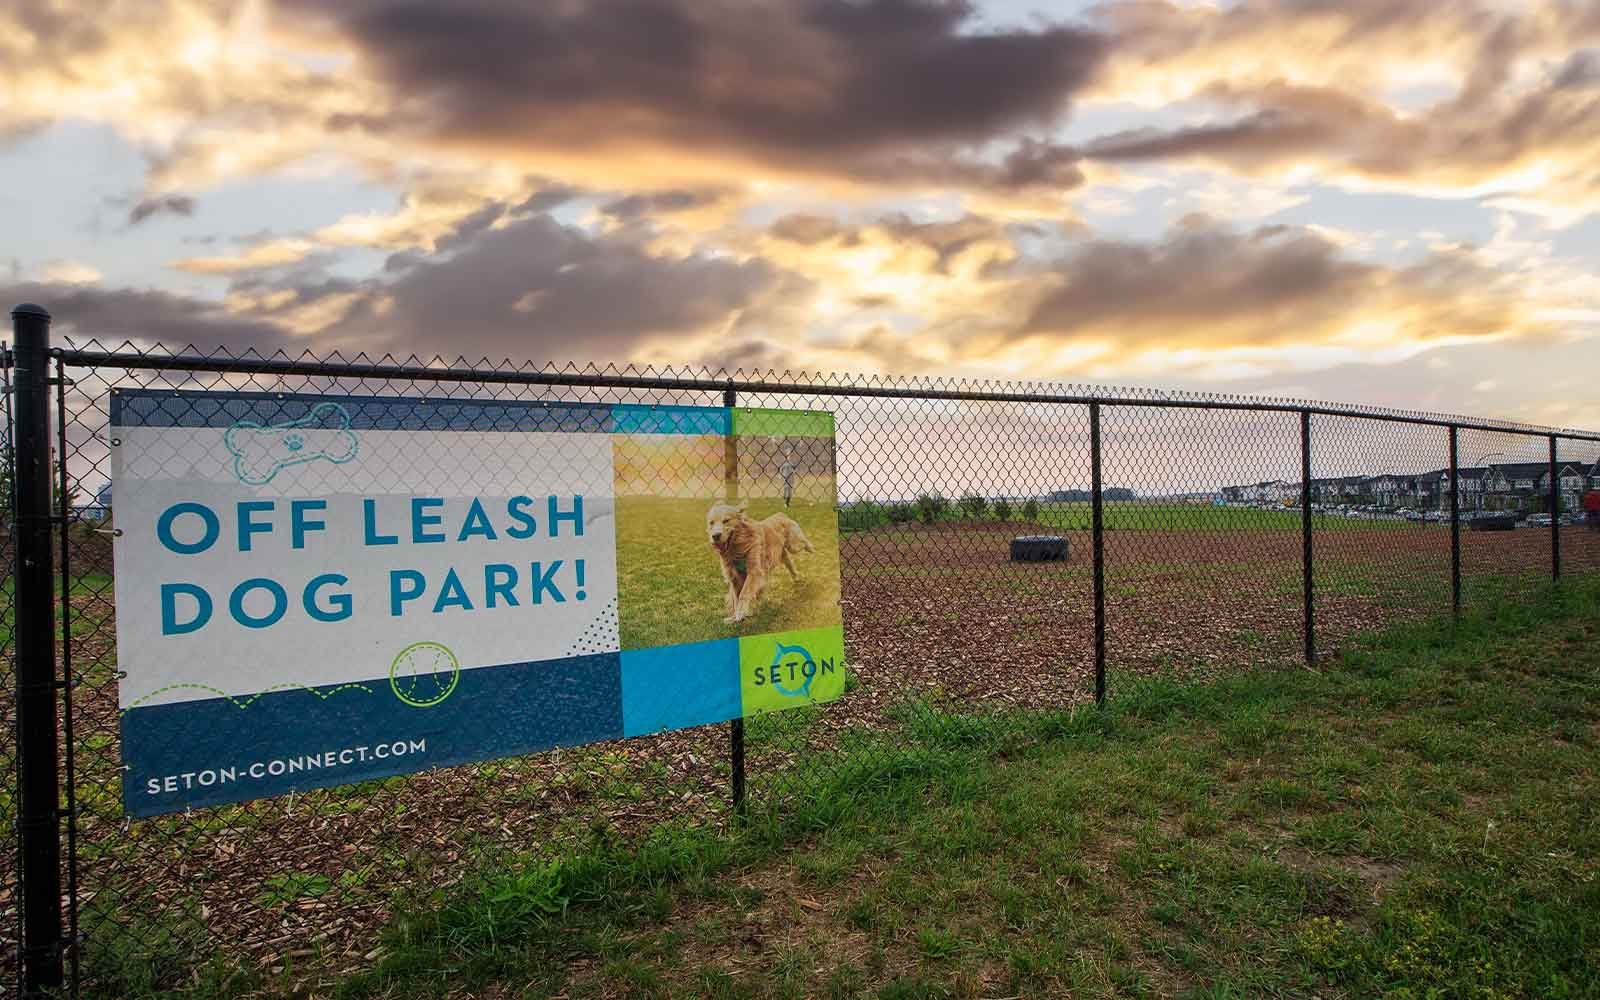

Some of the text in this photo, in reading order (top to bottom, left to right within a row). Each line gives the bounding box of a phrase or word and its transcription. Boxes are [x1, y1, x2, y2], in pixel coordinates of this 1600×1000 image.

[156, 494, 585, 555] OFF LEASH
[160, 558, 588, 636] DOG PARK!
[754, 655, 835, 686] SETON
[146, 738, 427, 795] SETON-CONNECT.COM
